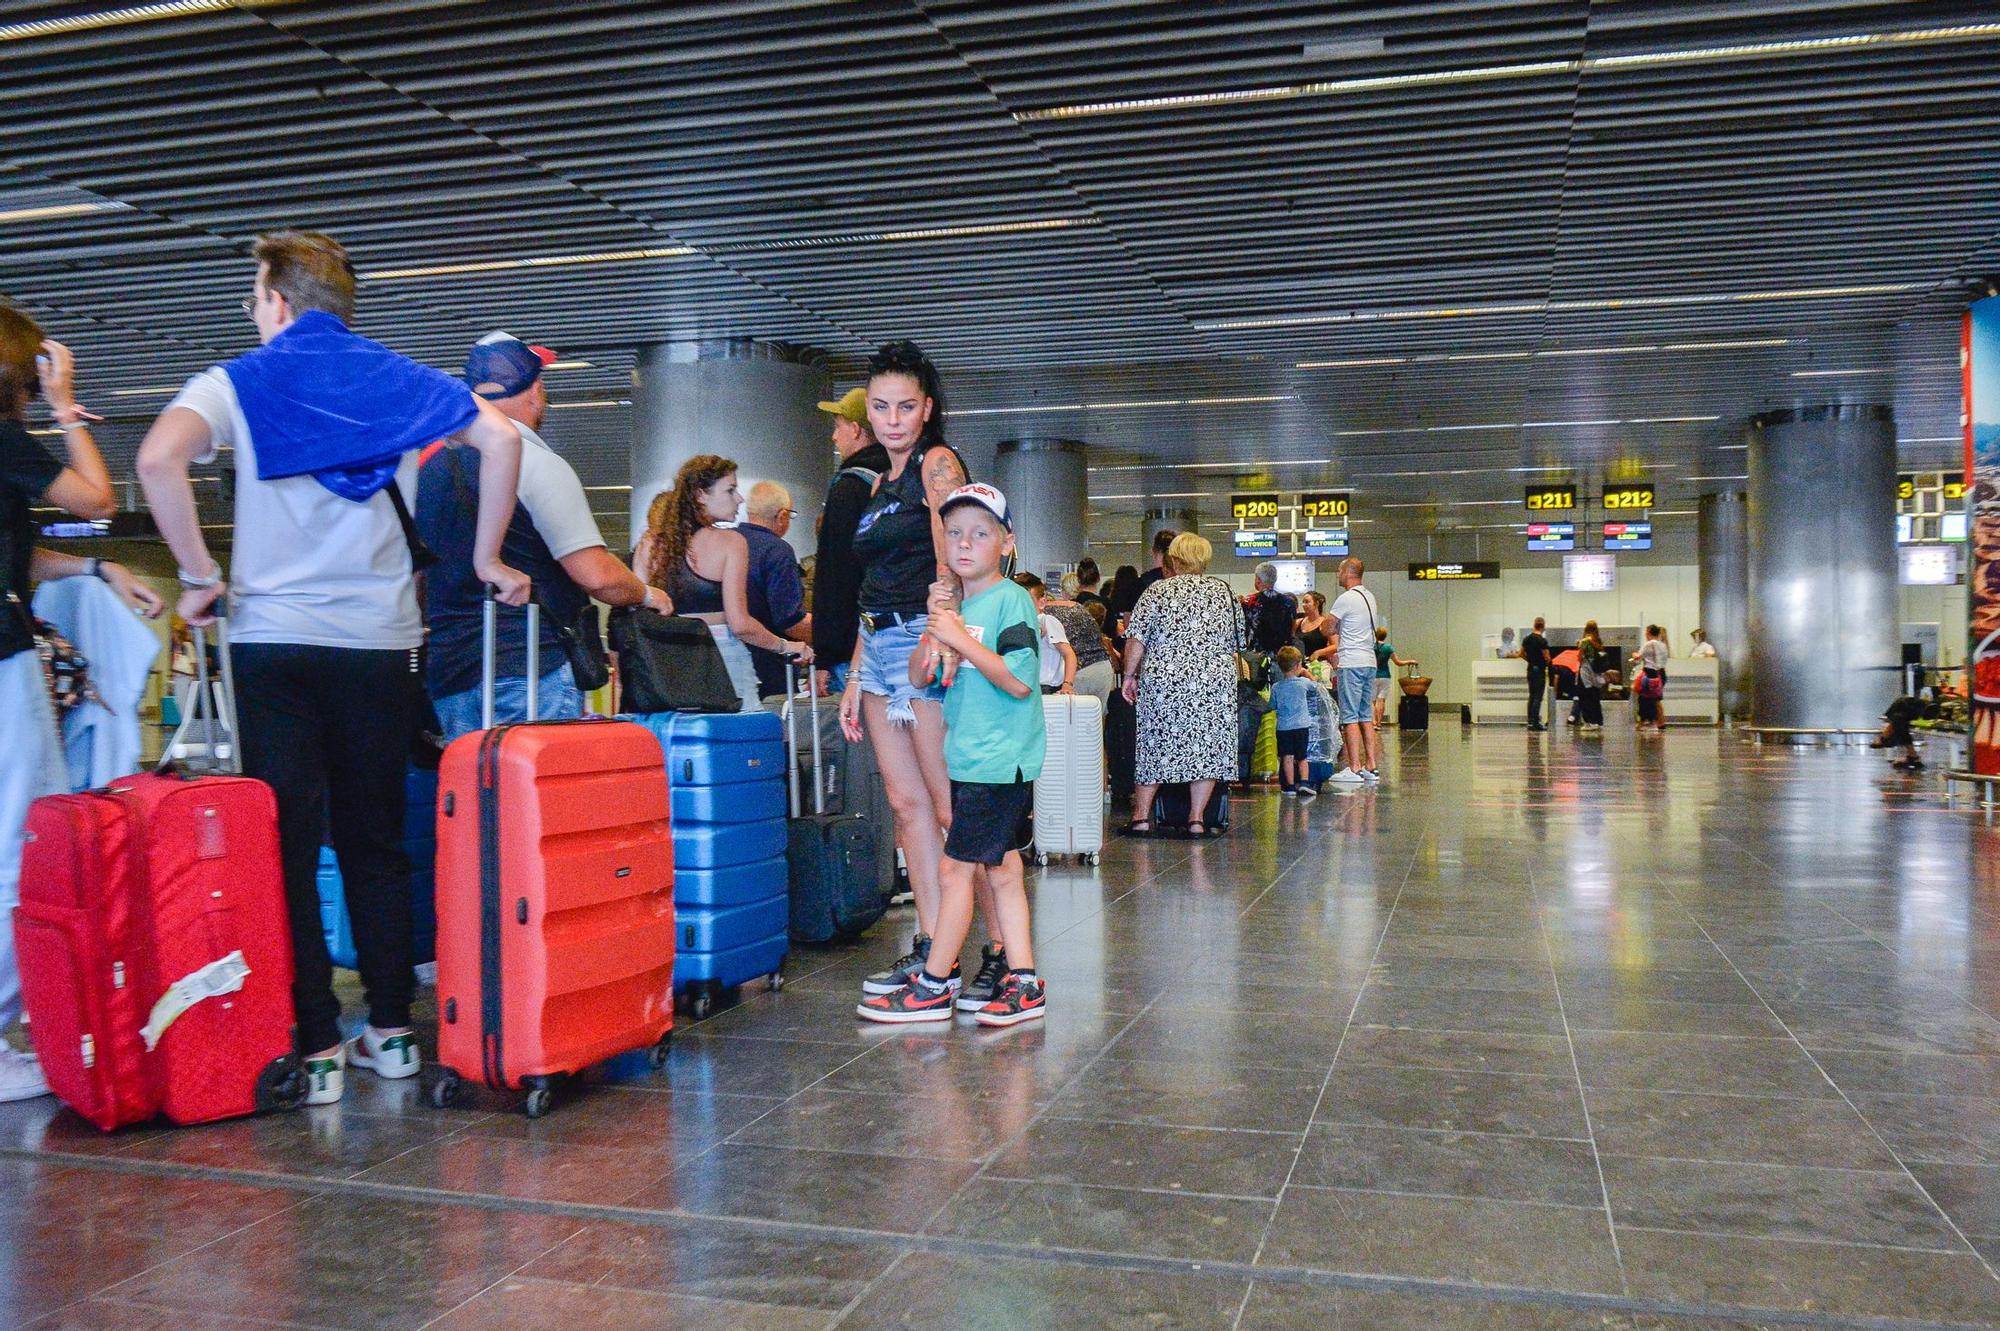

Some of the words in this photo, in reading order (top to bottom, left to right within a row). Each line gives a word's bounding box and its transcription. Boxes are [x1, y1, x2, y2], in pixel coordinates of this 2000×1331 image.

[959, 486, 996, 500] NASA
[1543, 492, 1573, 509] 211
[1620, 491, 1653, 508] 212
[1248, 501, 1277, 518] 209
[1319, 500, 1347, 516] 210
